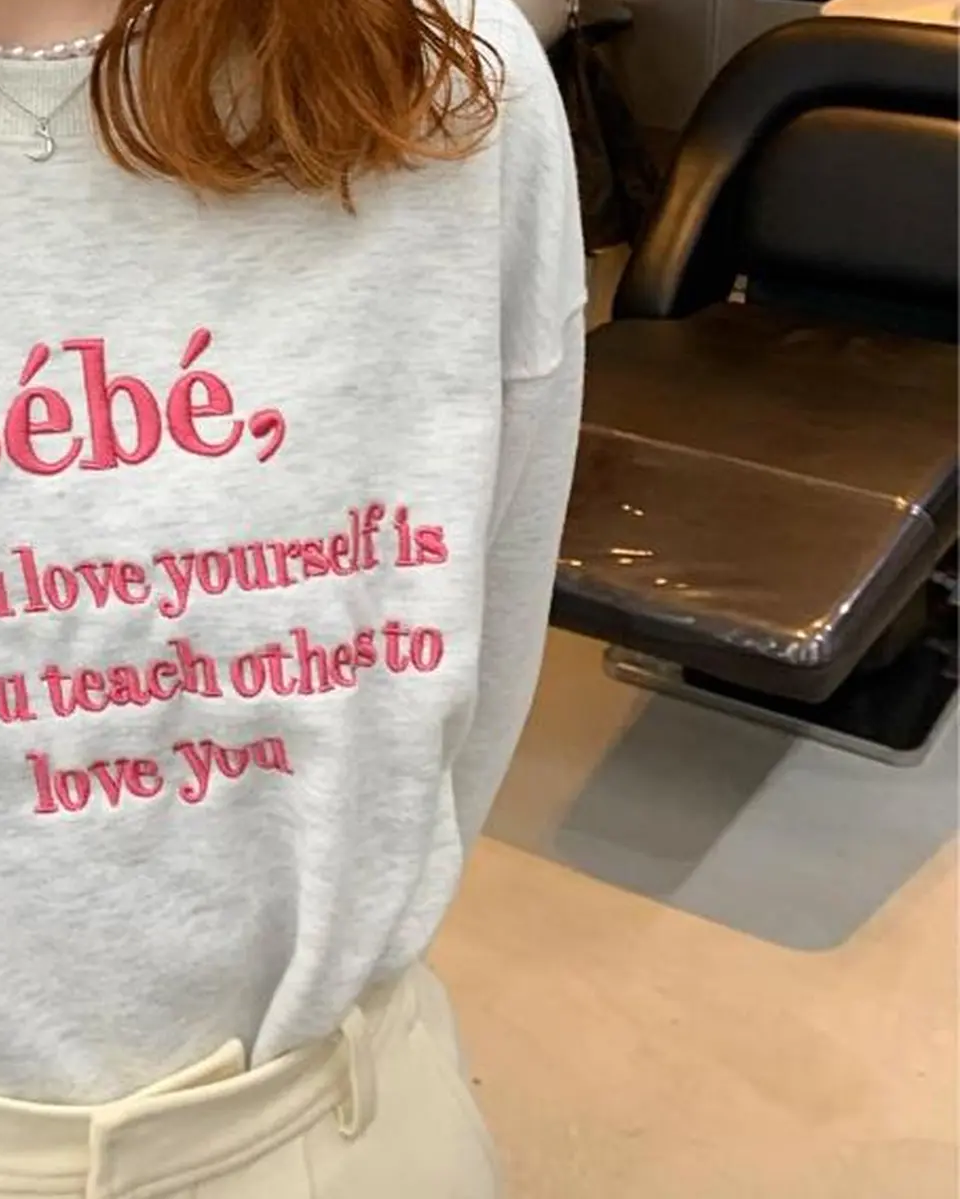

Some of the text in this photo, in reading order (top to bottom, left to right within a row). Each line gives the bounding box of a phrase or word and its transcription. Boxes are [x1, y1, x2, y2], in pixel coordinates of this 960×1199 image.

[15, 545, 151, 614] love
[152, 502, 386, 621] yourself
[394, 502, 449, 569] is
[41, 637, 223, 717] teach
[379, 619, 445, 674] to
[25, 736, 293, 815] love you
